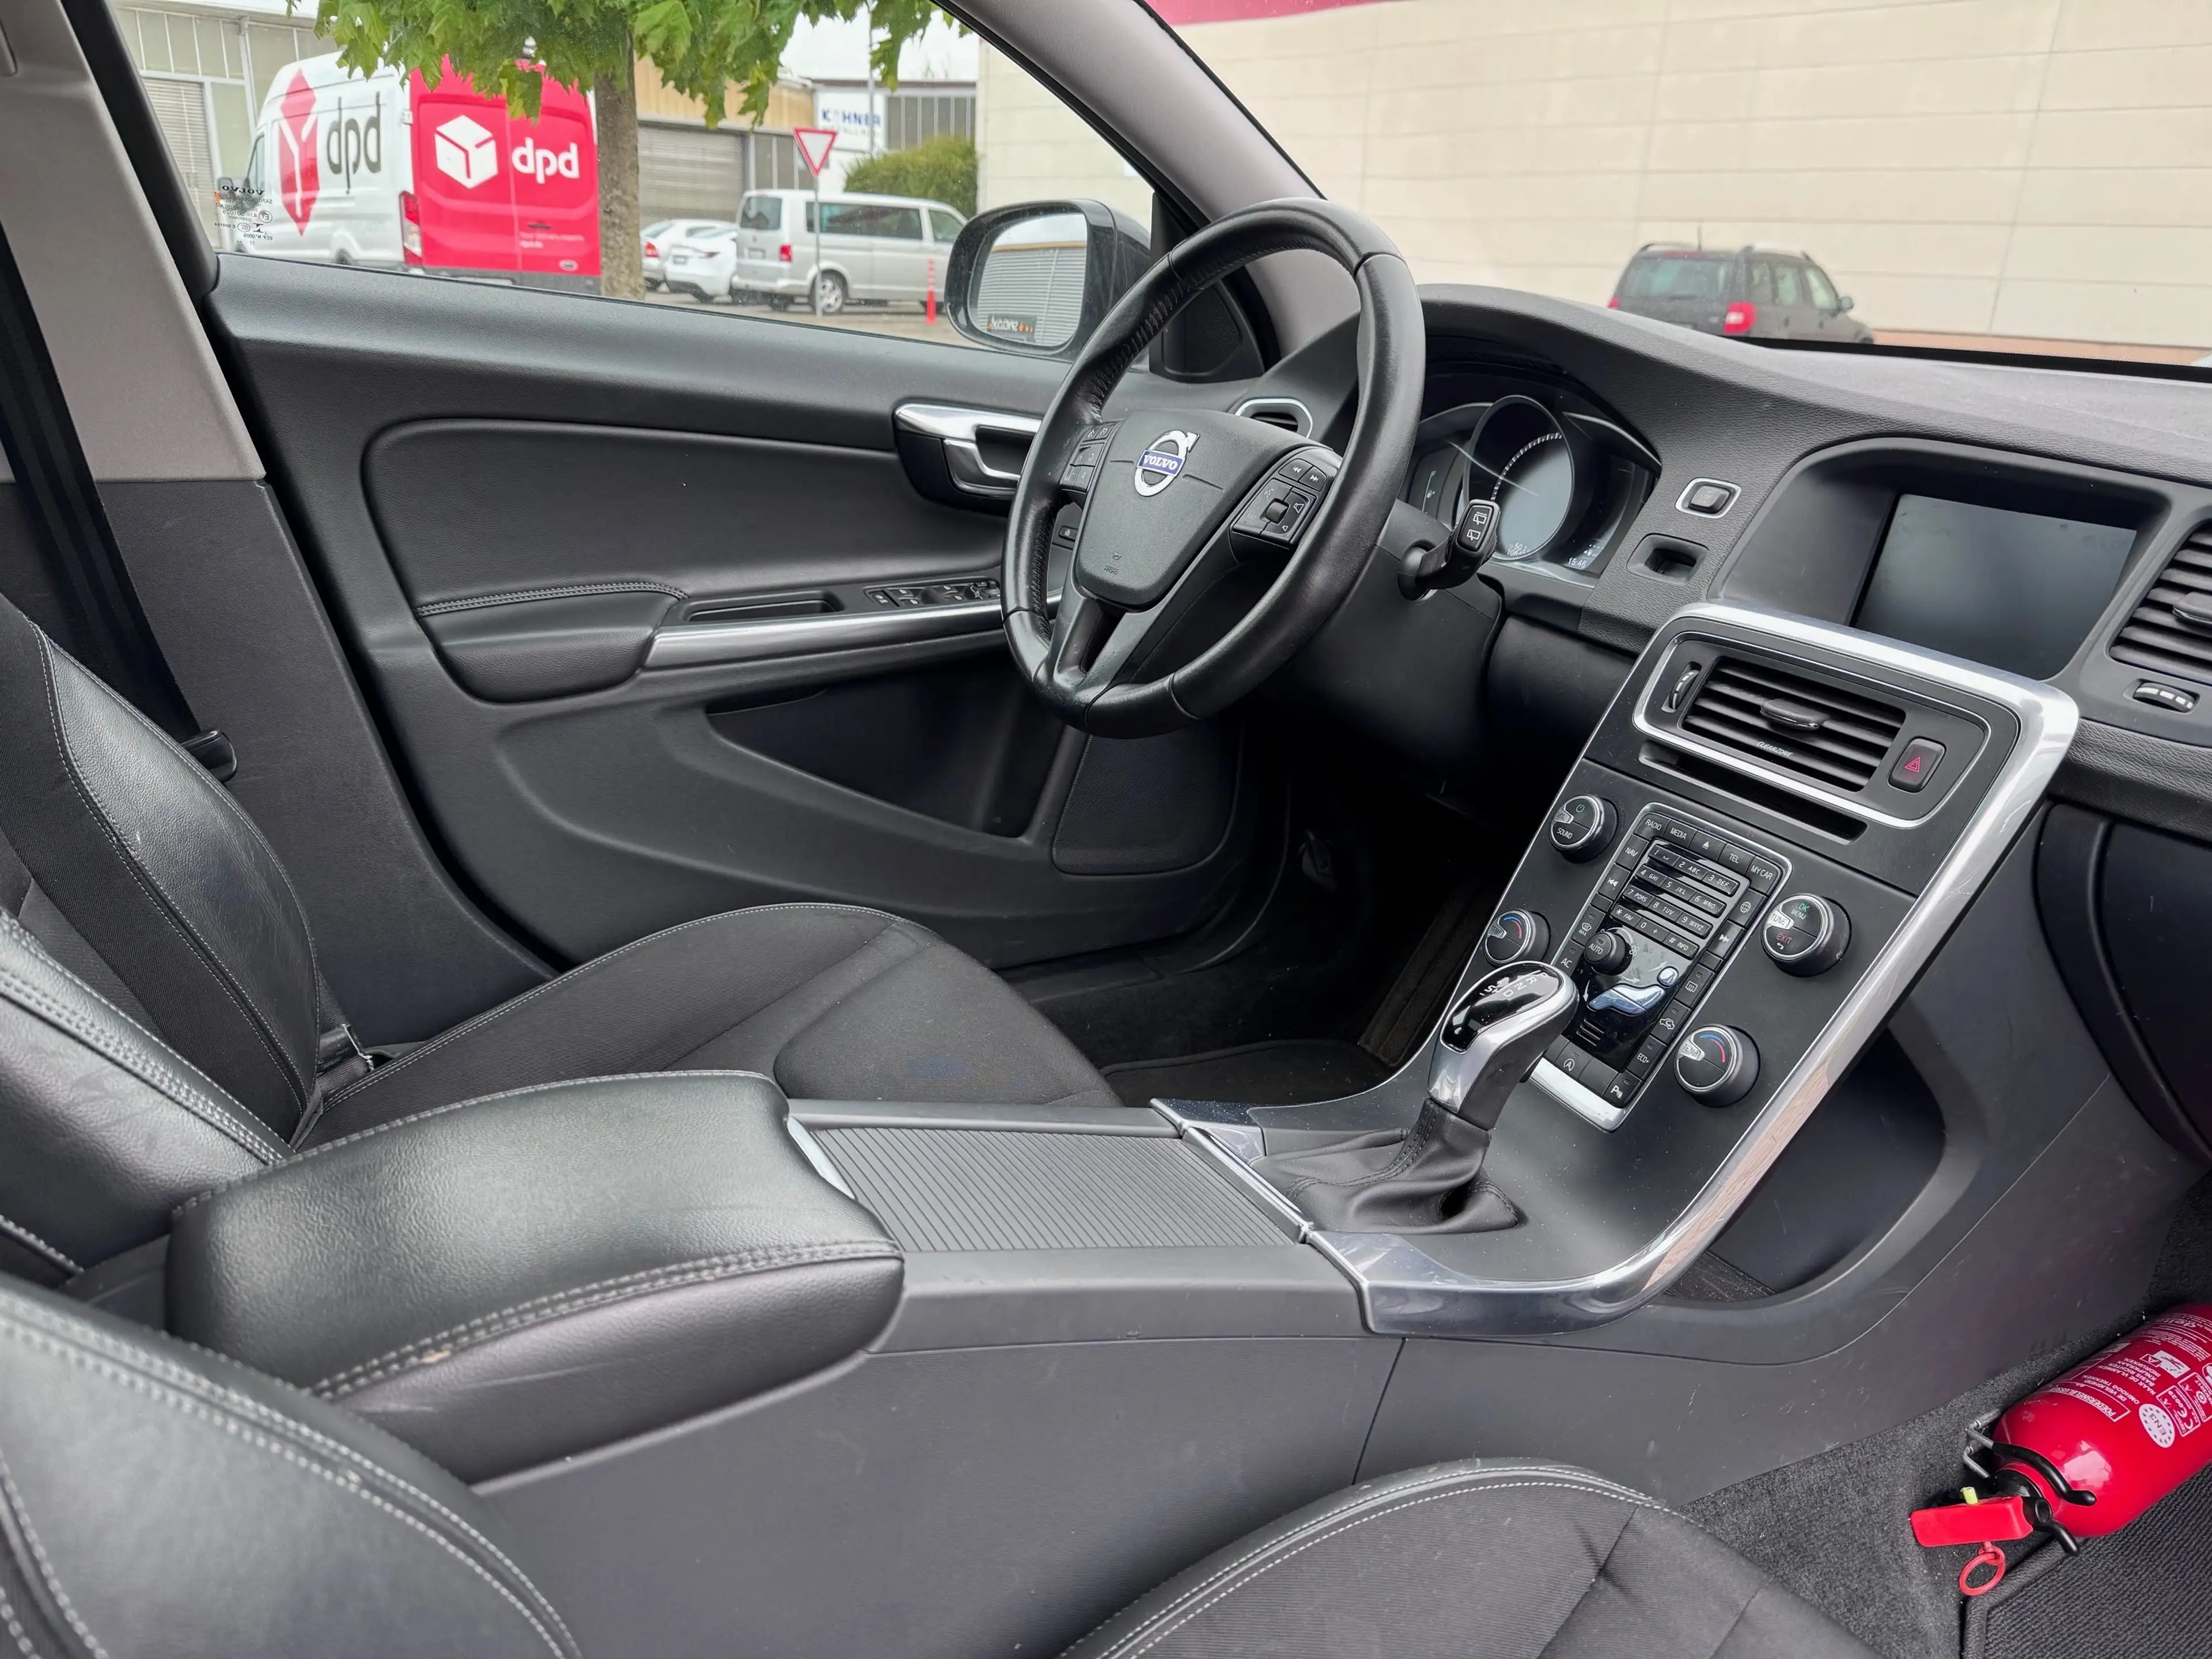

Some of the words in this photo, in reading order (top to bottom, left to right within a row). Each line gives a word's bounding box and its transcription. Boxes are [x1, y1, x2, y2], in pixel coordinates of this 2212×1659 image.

[821, 108, 881, 126] KHNER
[327, 91, 381, 194] dpd
[512, 137, 579, 184] dpd
[1143, 455, 1178, 470] VOLVO
[1568, 557, 1586, 567] 15:46
[1756, 741, 1793, 757] CLEANZONE
[1556, 812, 1565, 820] VOL
[1645, 819, 1662, 831] RADIO
[1556, 828, 1573, 839] SOUND
[1670, 828, 1687, 840] MEDIA
[1625, 847, 1638, 857] NAV
[1729, 853, 1739, 863] TEL
[1688, 866, 1700, 874] ABC
[1751, 865, 1760, 874] MY
[1760, 870, 1773, 880] CAR
[1717, 878, 1729, 887] DEF
[1675, 887, 1685, 895] JKL
[1703, 900, 1715, 908] MNO
[1798, 903, 1809, 912] OK
[1662, 907, 1674, 915] TUV
[1790, 909, 1806, 919] MENU
[1771, 914, 1785, 925] TUNE
[1491, 925, 1502, 934] TEMP
[1689, 921, 1704, 931] WXYZ
[1776, 933, 1792, 944] EXIT
[1588, 943, 1603, 955] AUTO
[1677, 942, 1689, 950] INFO
[1560, 958, 1572, 968] AC
[1514, 982, 1527, 991] N
[1683, 1044, 1699, 1056] TEMP
[2108, 1363, 2135, 1375] RICHTEN
[2135, 1373, 2155, 1387] BASIS
[2138, 1381, 2157, 1395] NAAR
[2112, 1385, 2140, 1404] OMHOOG
[2117, 1393, 2128, 1402] DE
[2149, 1413, 2166, 1435] EN3
